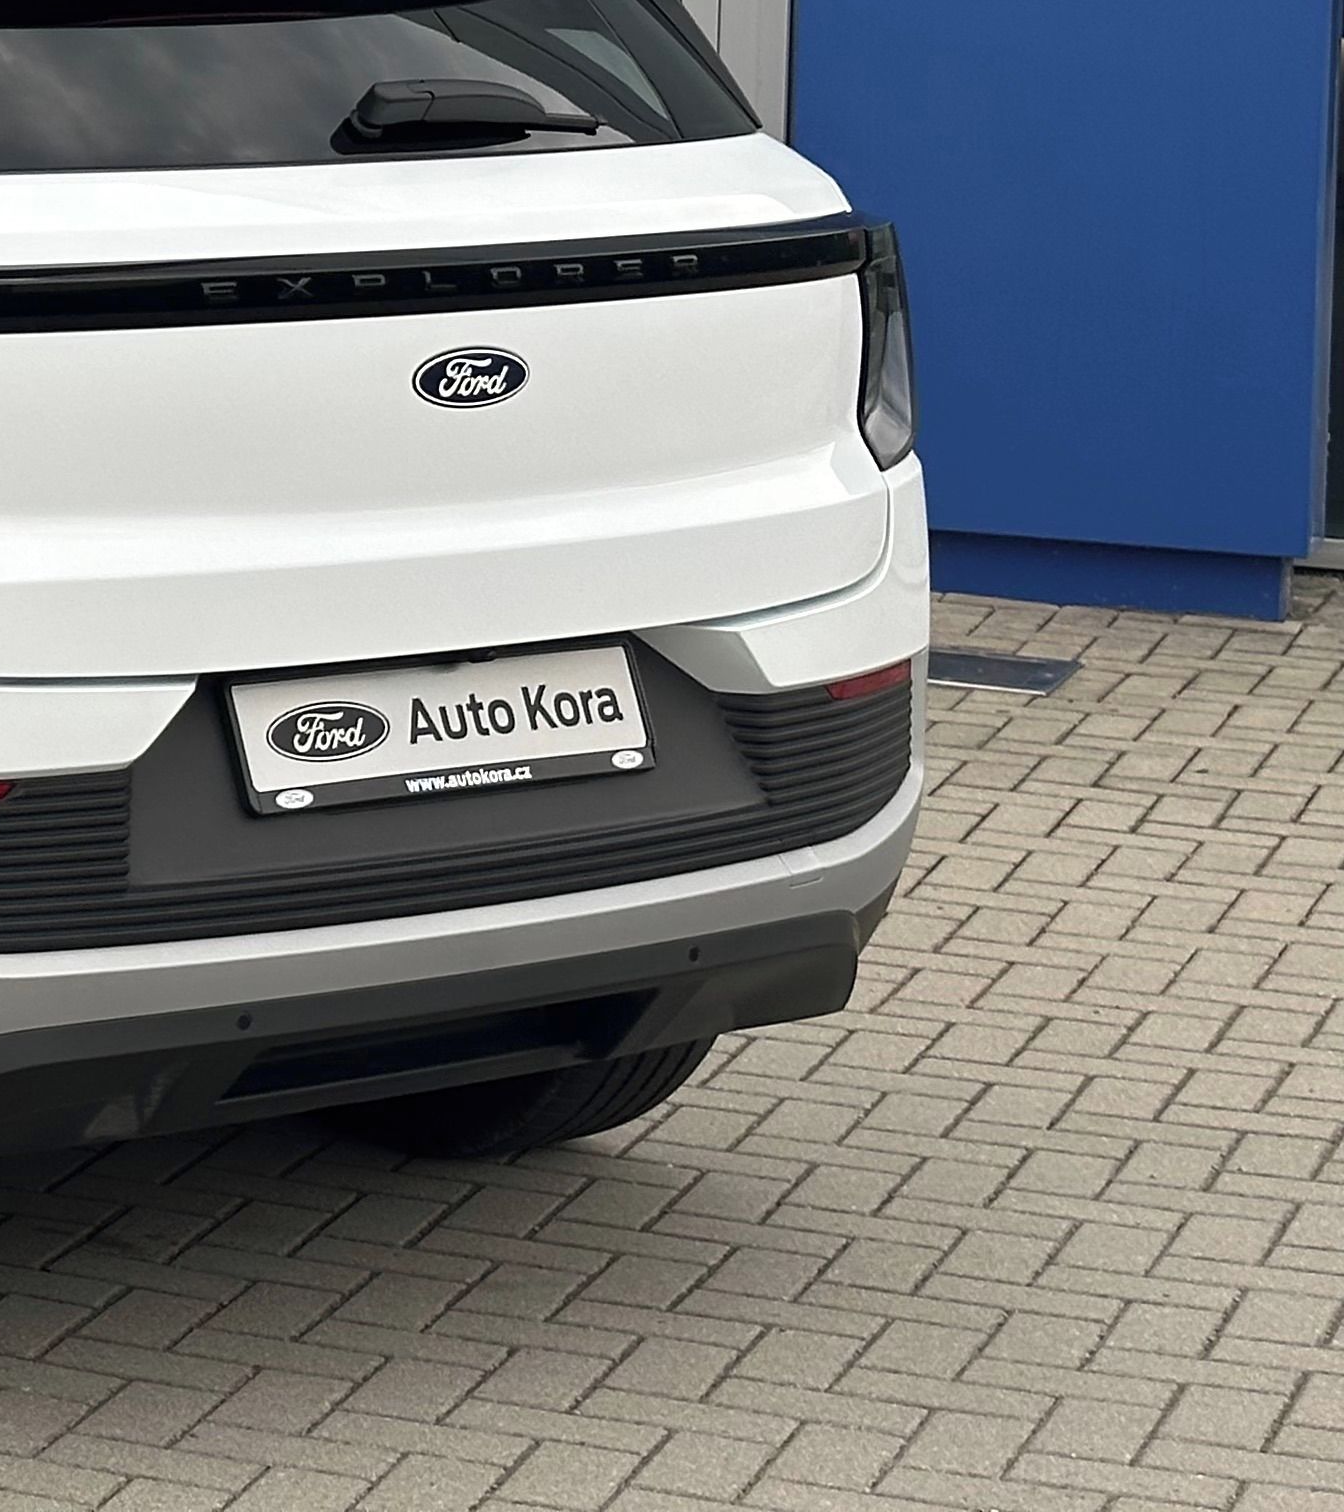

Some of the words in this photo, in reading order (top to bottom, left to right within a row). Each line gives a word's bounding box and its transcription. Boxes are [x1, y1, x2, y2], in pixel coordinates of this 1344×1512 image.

[200, 253, 702, 305] EXPLORER
[438, 357, 511, 398] Ford
[292, 711, 367, 754] Ford
[408, 692, 515, 746] Auto
[519, 683, 624, 732] Kora
[404, 764, 533, 793] www.autokora.cz
